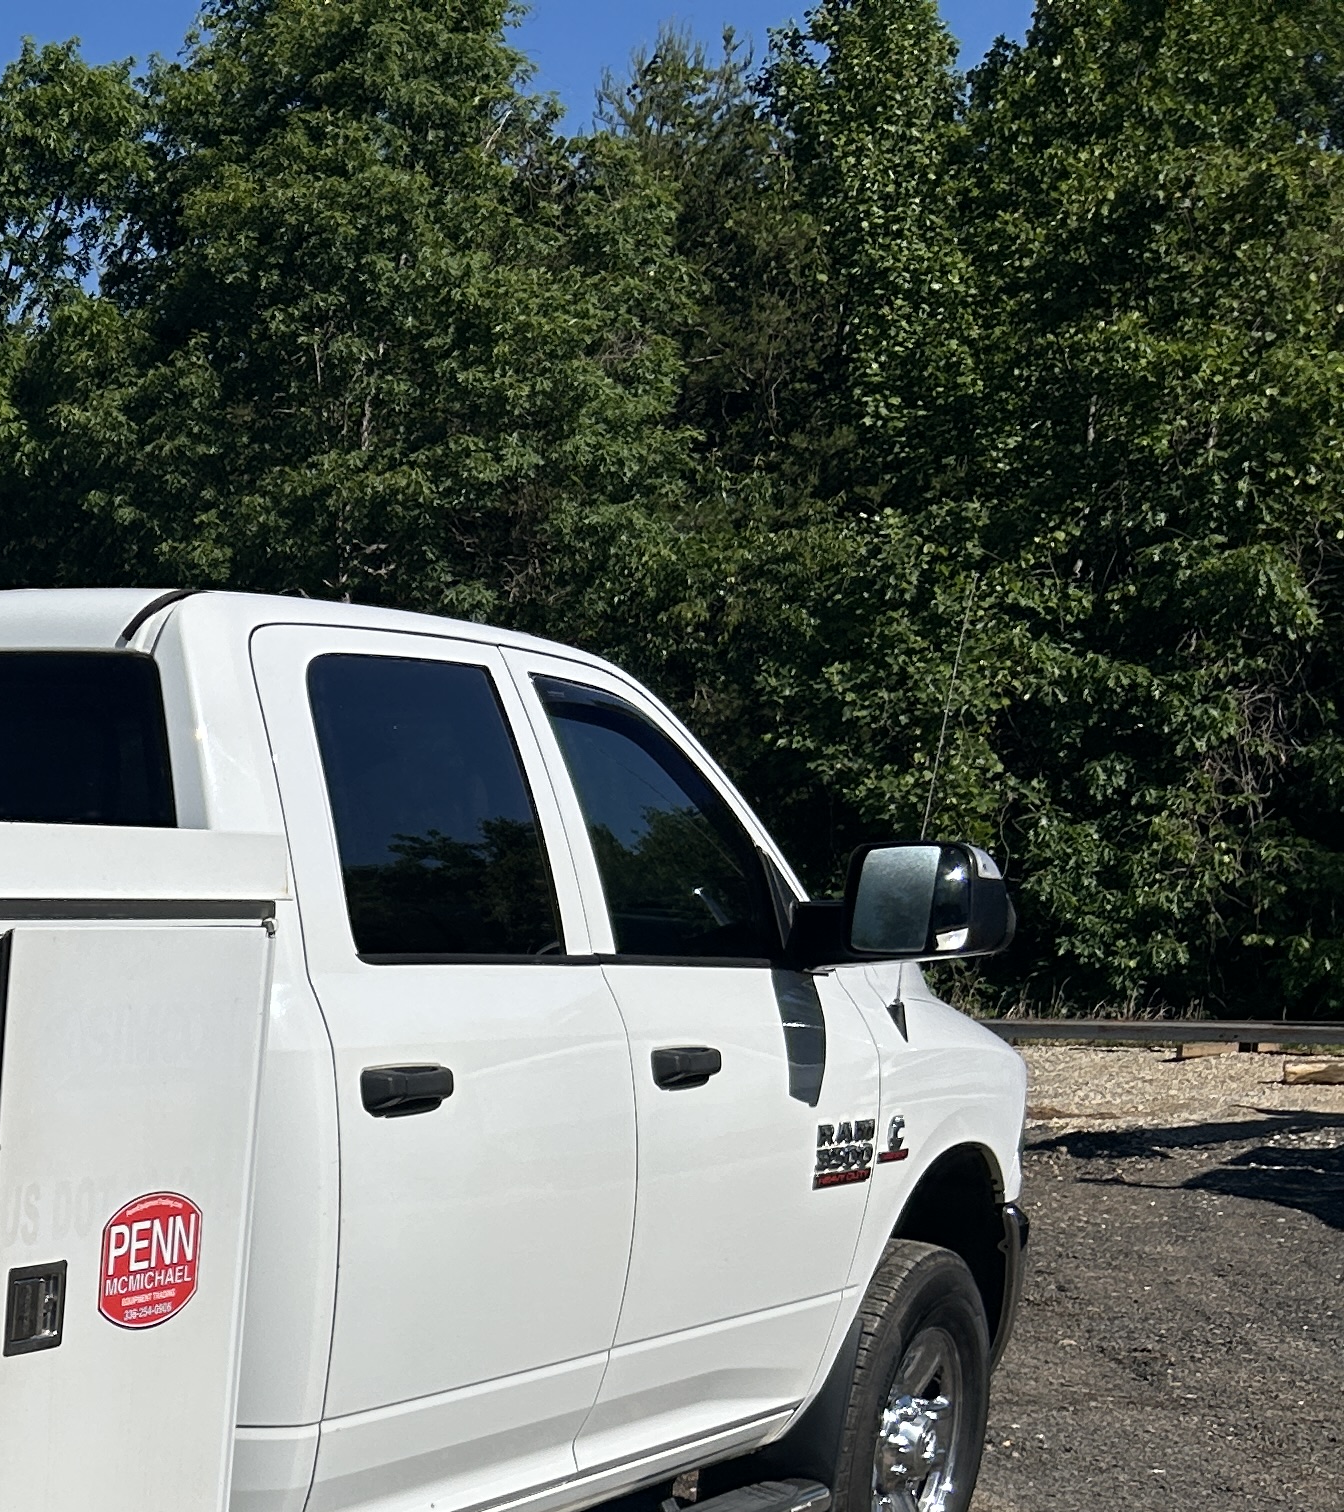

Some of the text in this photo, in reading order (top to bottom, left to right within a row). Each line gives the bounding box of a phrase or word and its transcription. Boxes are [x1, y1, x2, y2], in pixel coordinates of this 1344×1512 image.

[816, 1118, 876, 1148] RAM
[818, 1169, 870, 1185] HEAVY DUTY
[107, 1213, 196, 1276] PENN
[105, 1265, 192, 1297] MCMICHAEL
